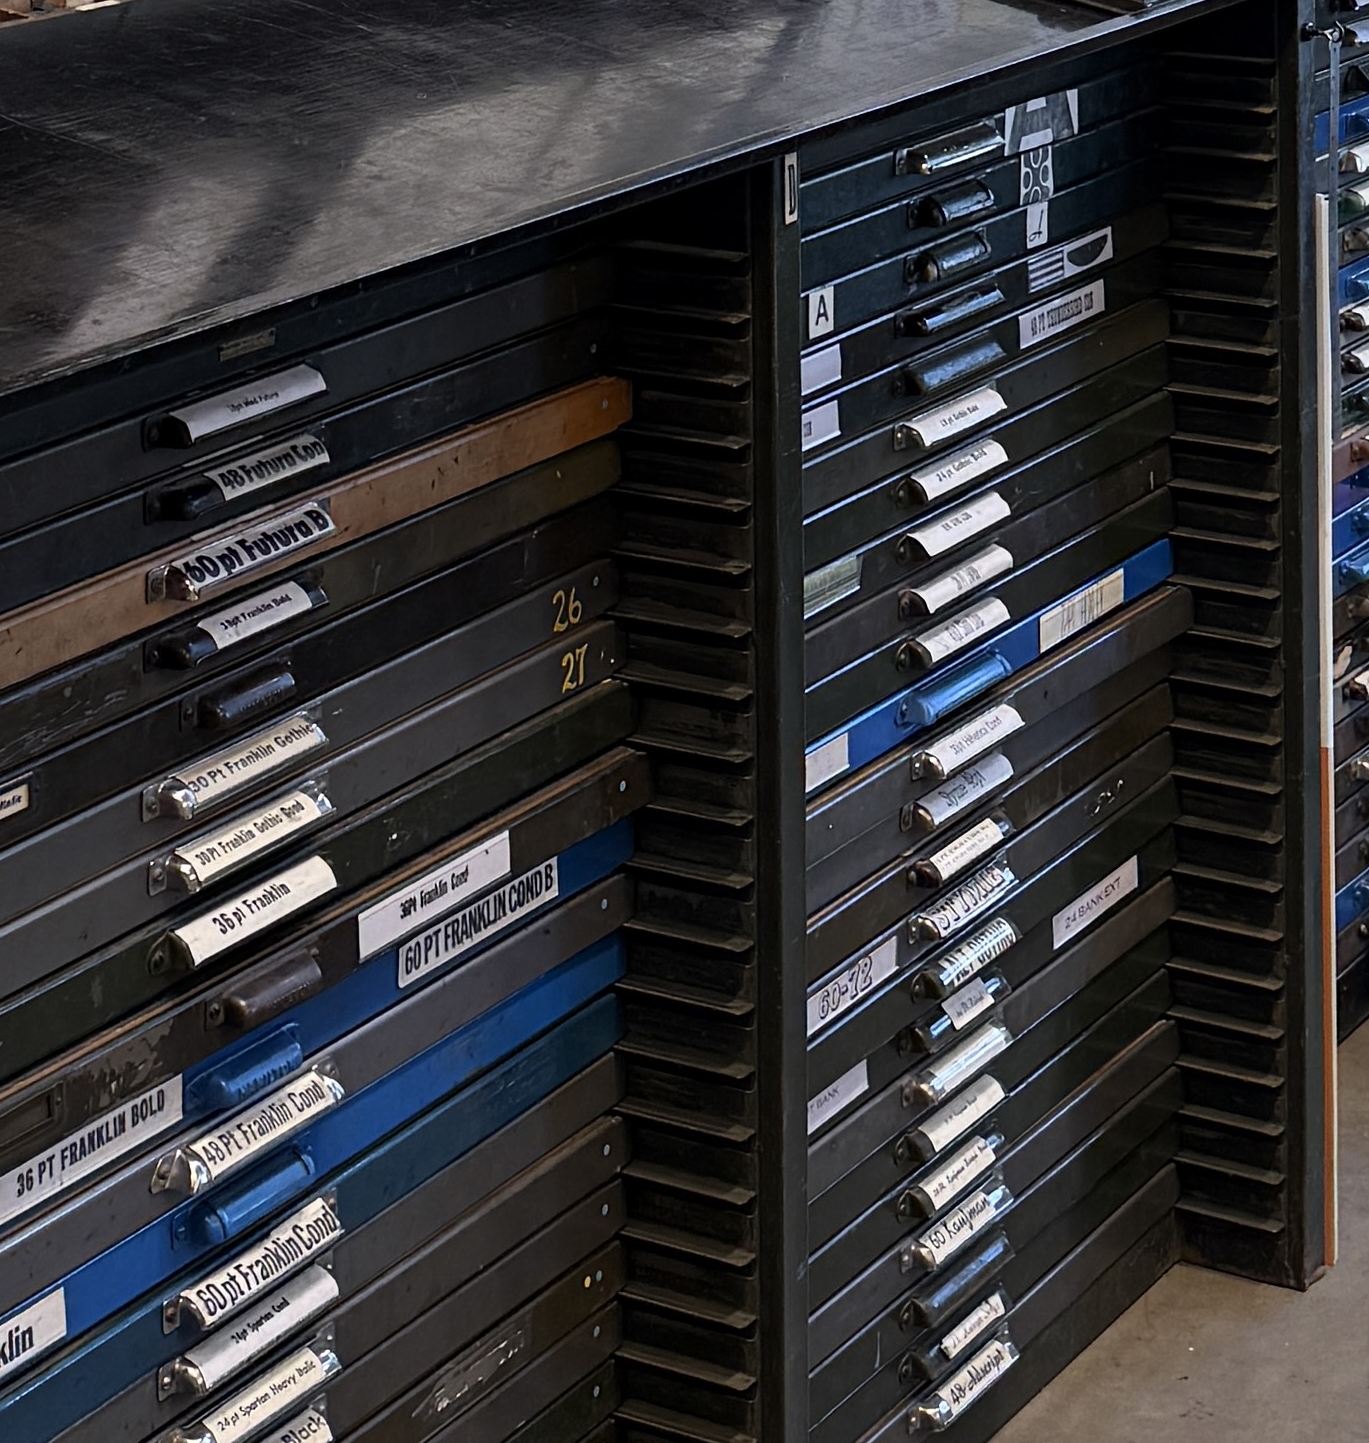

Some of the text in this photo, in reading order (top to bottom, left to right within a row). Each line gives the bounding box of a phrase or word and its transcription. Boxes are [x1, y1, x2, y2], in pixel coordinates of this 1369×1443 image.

[553, 589, 582, 632] 26
[562, 644, 587, 693] 27
[404, 876, 542, 974] 60 PT FRANKLIN COND
[16, 1089, 166, 1198] 36 PT FRANKLIN BOLD
